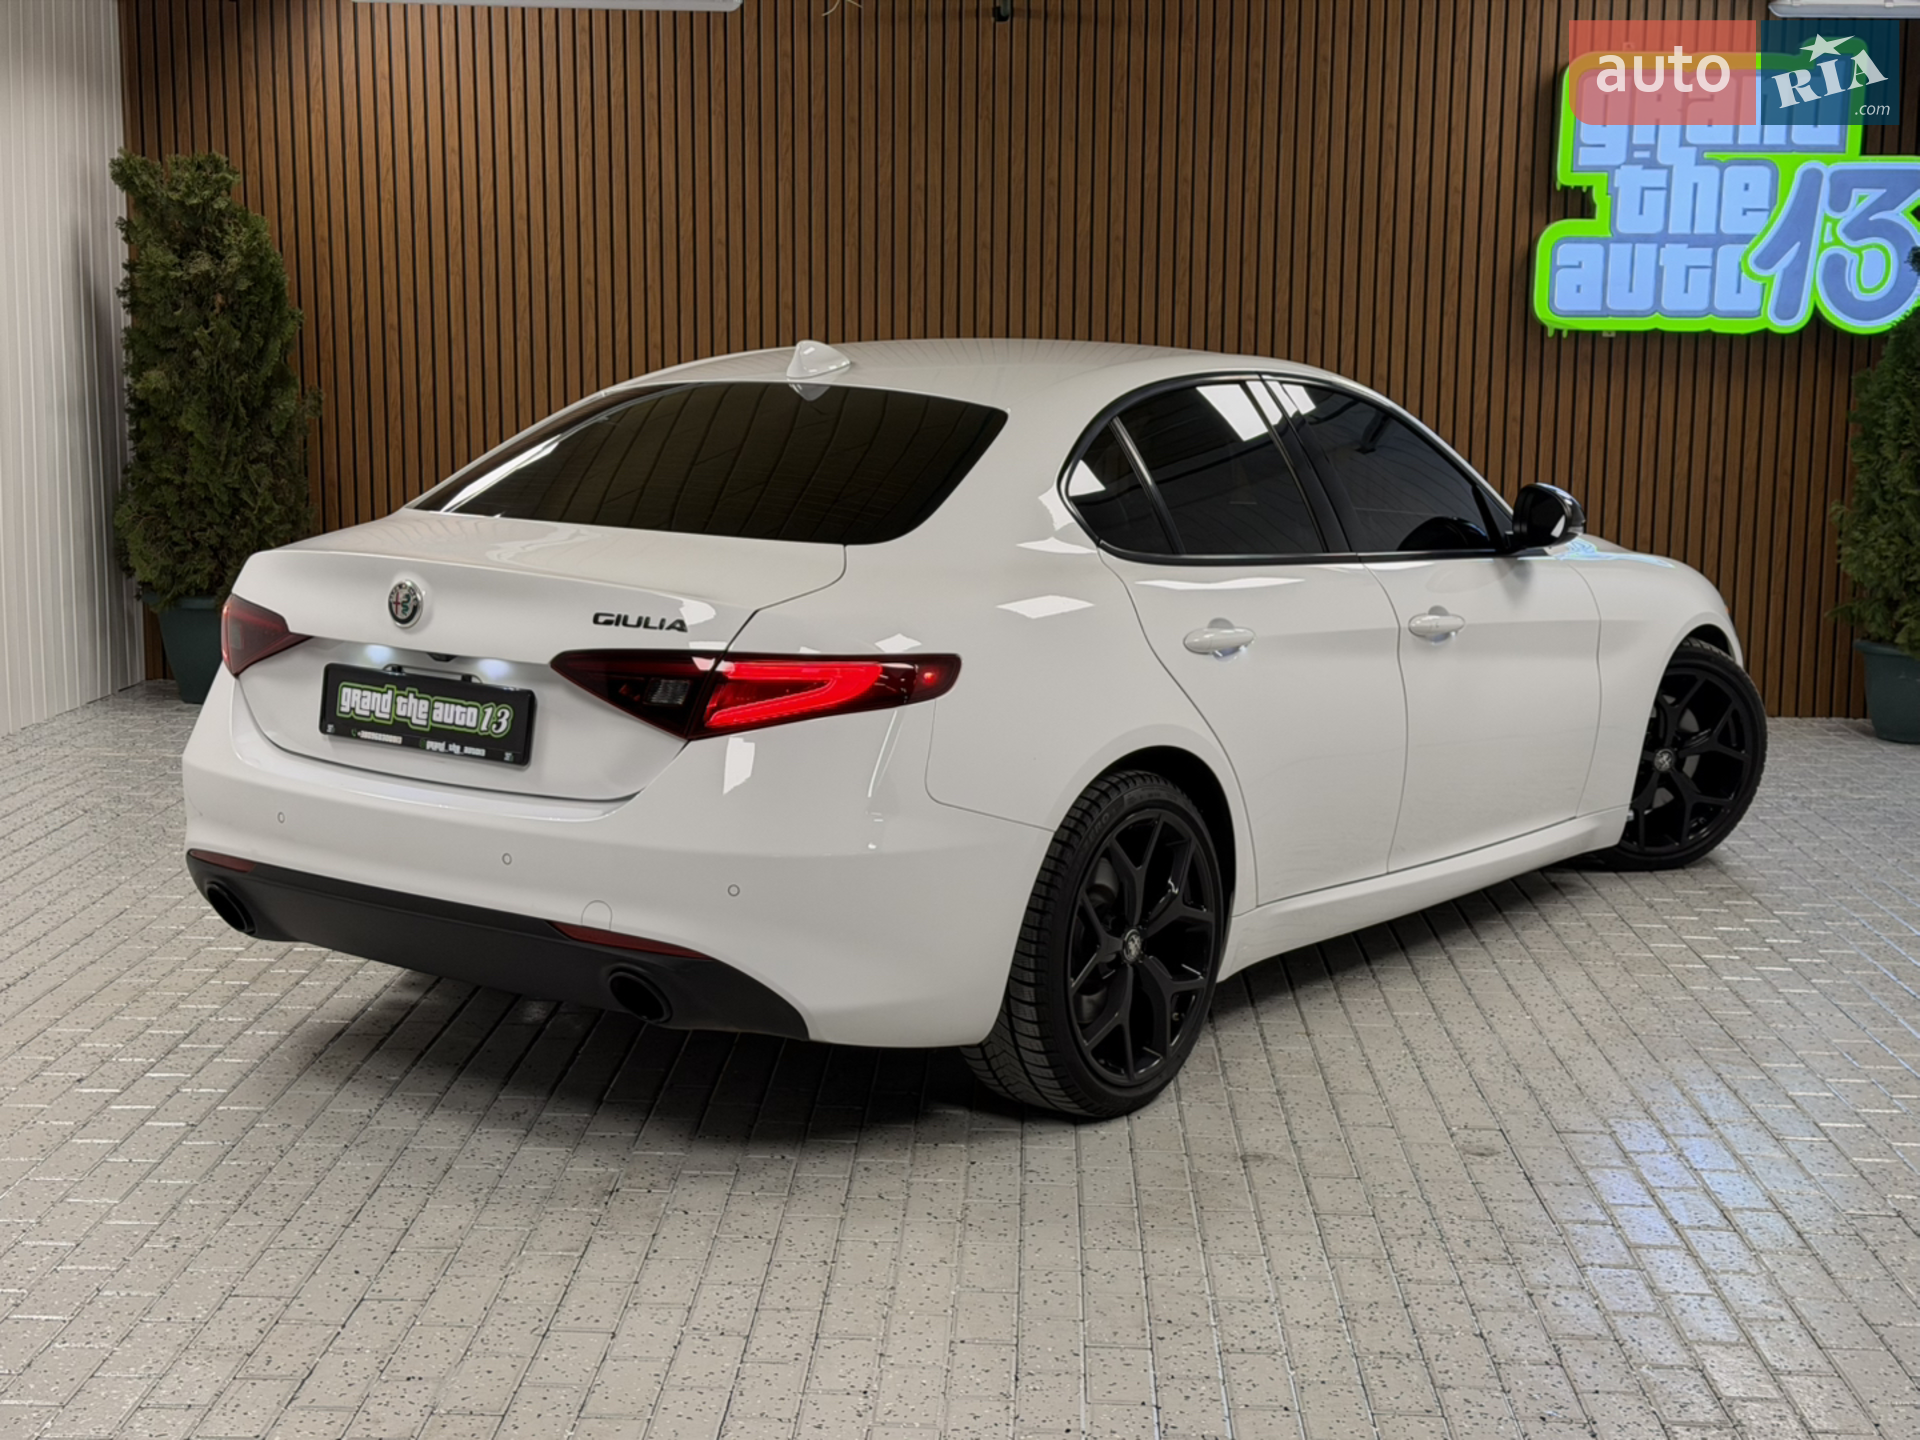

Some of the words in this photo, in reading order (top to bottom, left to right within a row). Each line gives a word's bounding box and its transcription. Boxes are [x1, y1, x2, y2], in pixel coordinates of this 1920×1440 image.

[1614, 148, 1772, 235] the
[1553, 242, 1763, 311] auto
[1748, 160, 1920, 328] 13
[592, 612, 688, 632] GIULIA
[395, 691, 430, 725] the
[432, 702, 479, 728] auto
[480, 706, 511, 734] 13
